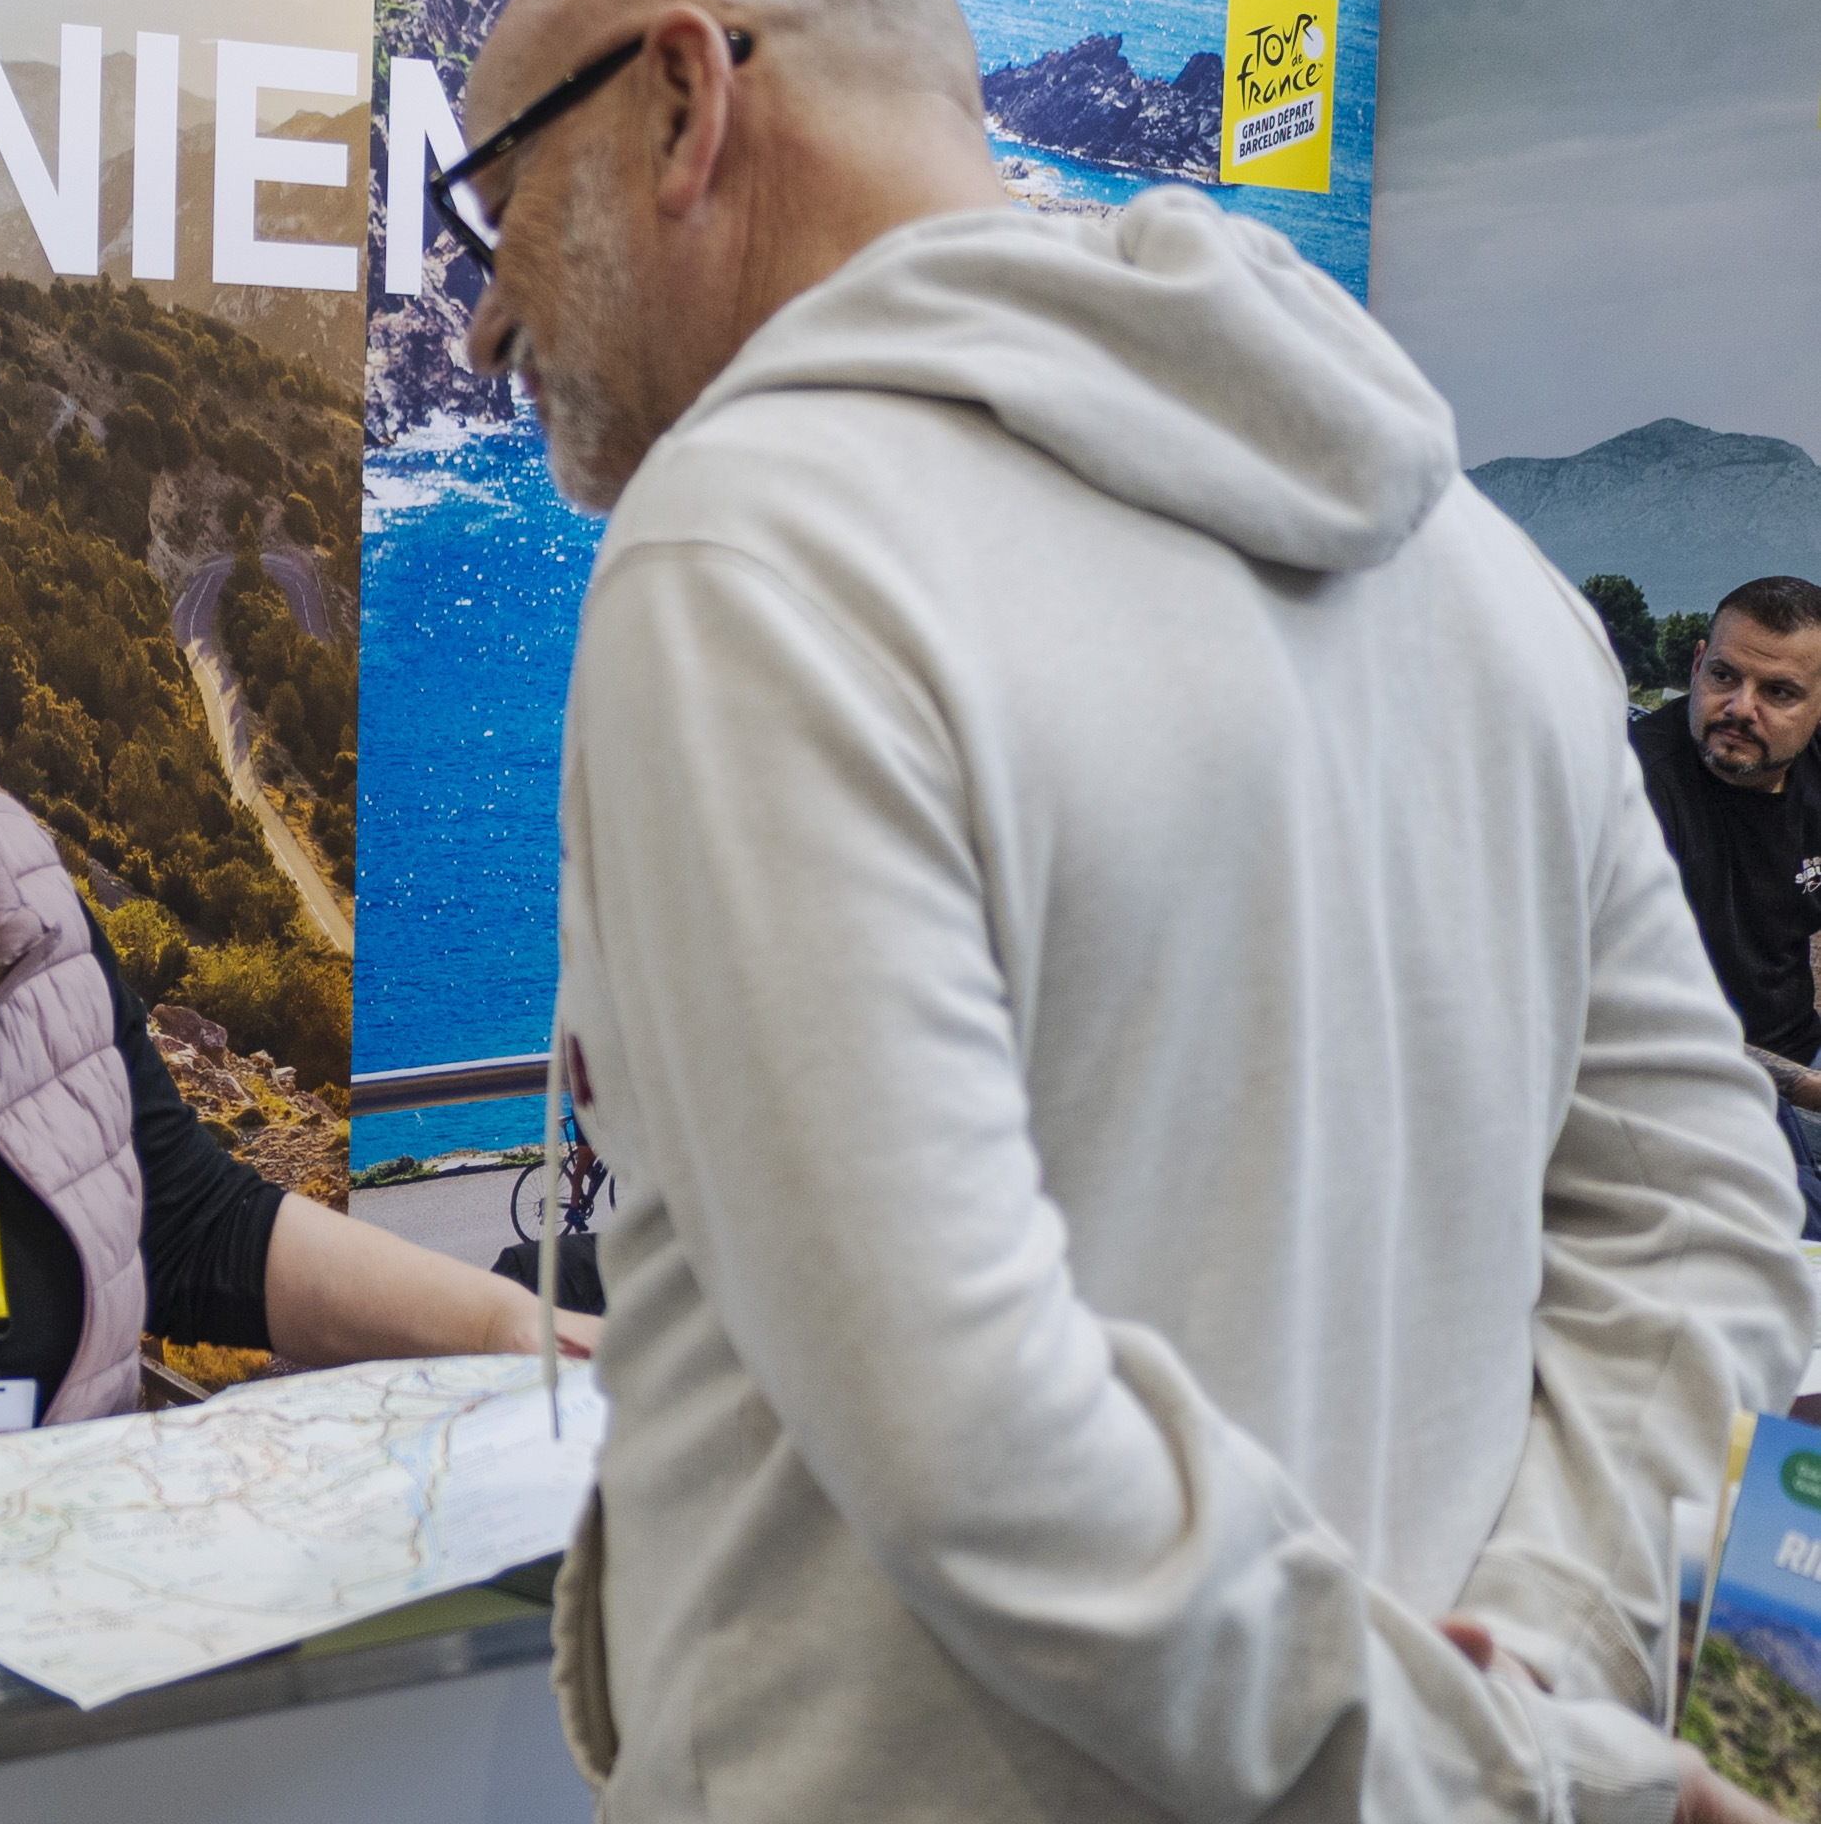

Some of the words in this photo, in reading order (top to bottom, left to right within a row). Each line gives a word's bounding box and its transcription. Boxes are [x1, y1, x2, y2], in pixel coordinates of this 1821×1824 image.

[1292, 49, 1303, 67] de
[1239, 125, 1292, 158] BARCELONE
[1294, 117, 1315, 138] 2026
[1242, 115, 1275, 139] GRAND
[1278, 100, 1314, 126] DÉPART
